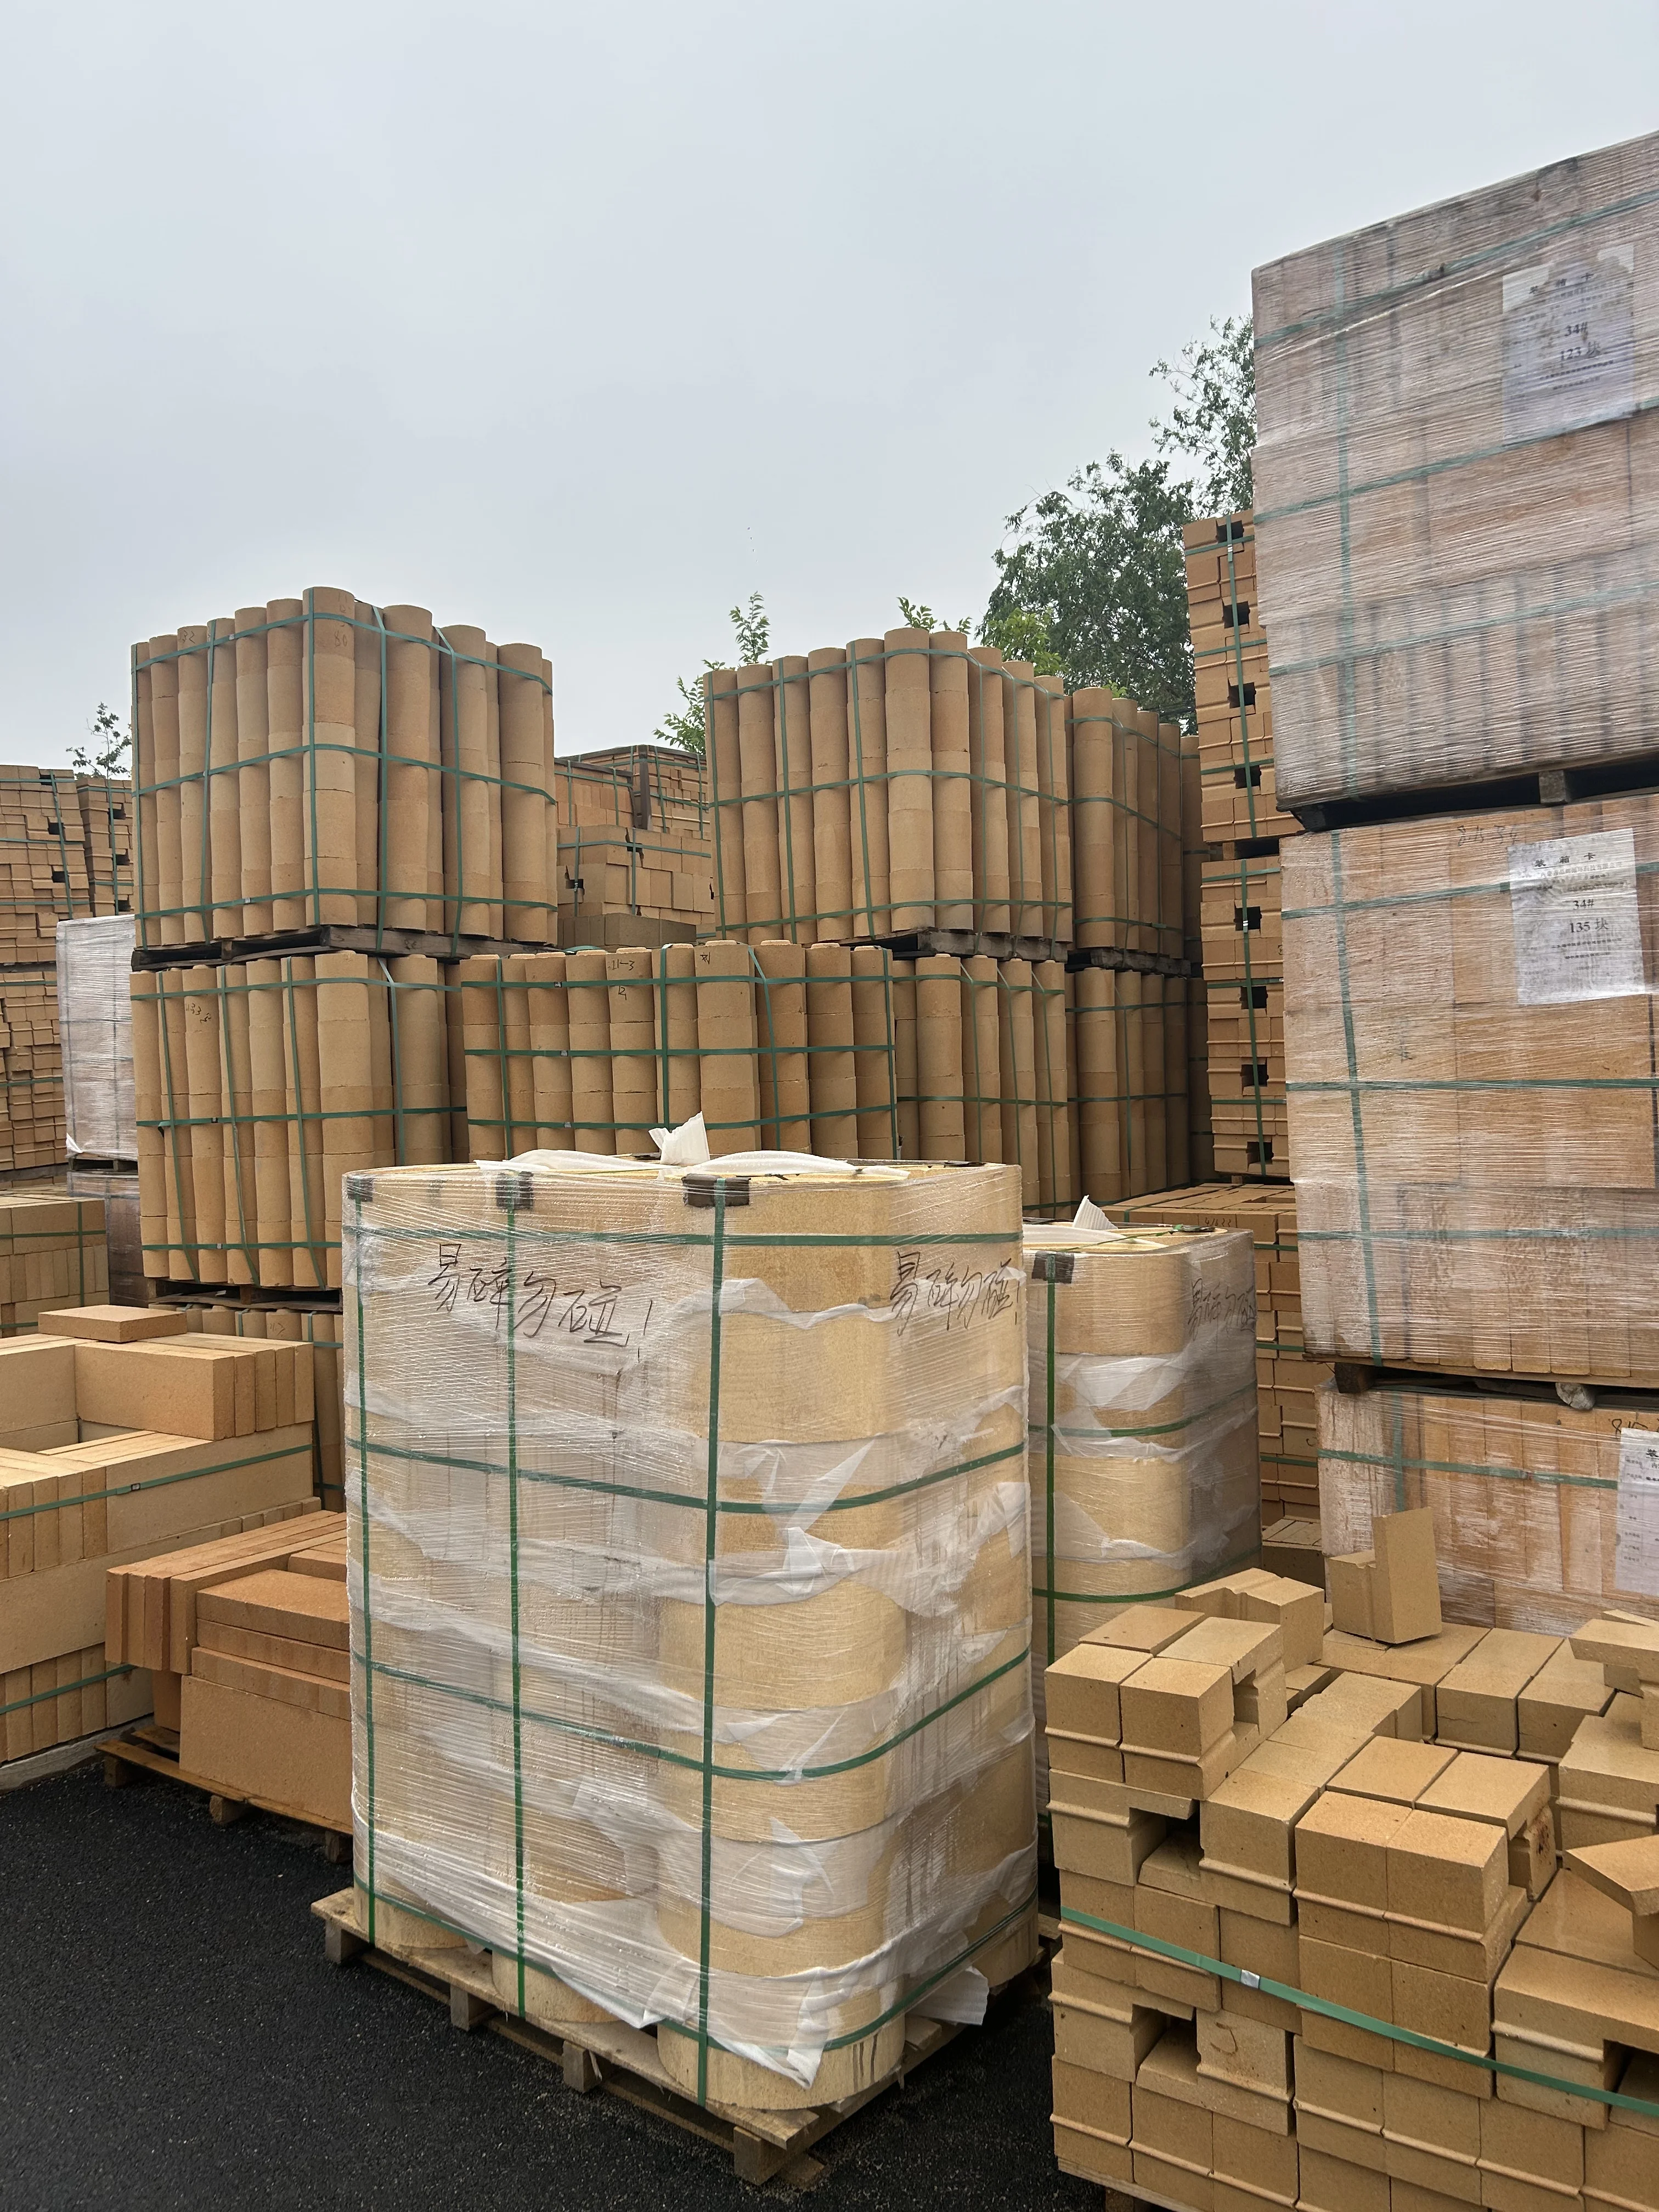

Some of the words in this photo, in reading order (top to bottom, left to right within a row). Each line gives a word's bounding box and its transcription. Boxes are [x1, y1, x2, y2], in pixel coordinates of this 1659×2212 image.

[1572, 899, 1595, 910] 34#
[1570, 921, 1590, 933] 135
[1594, 917, 1609, 931] 块
